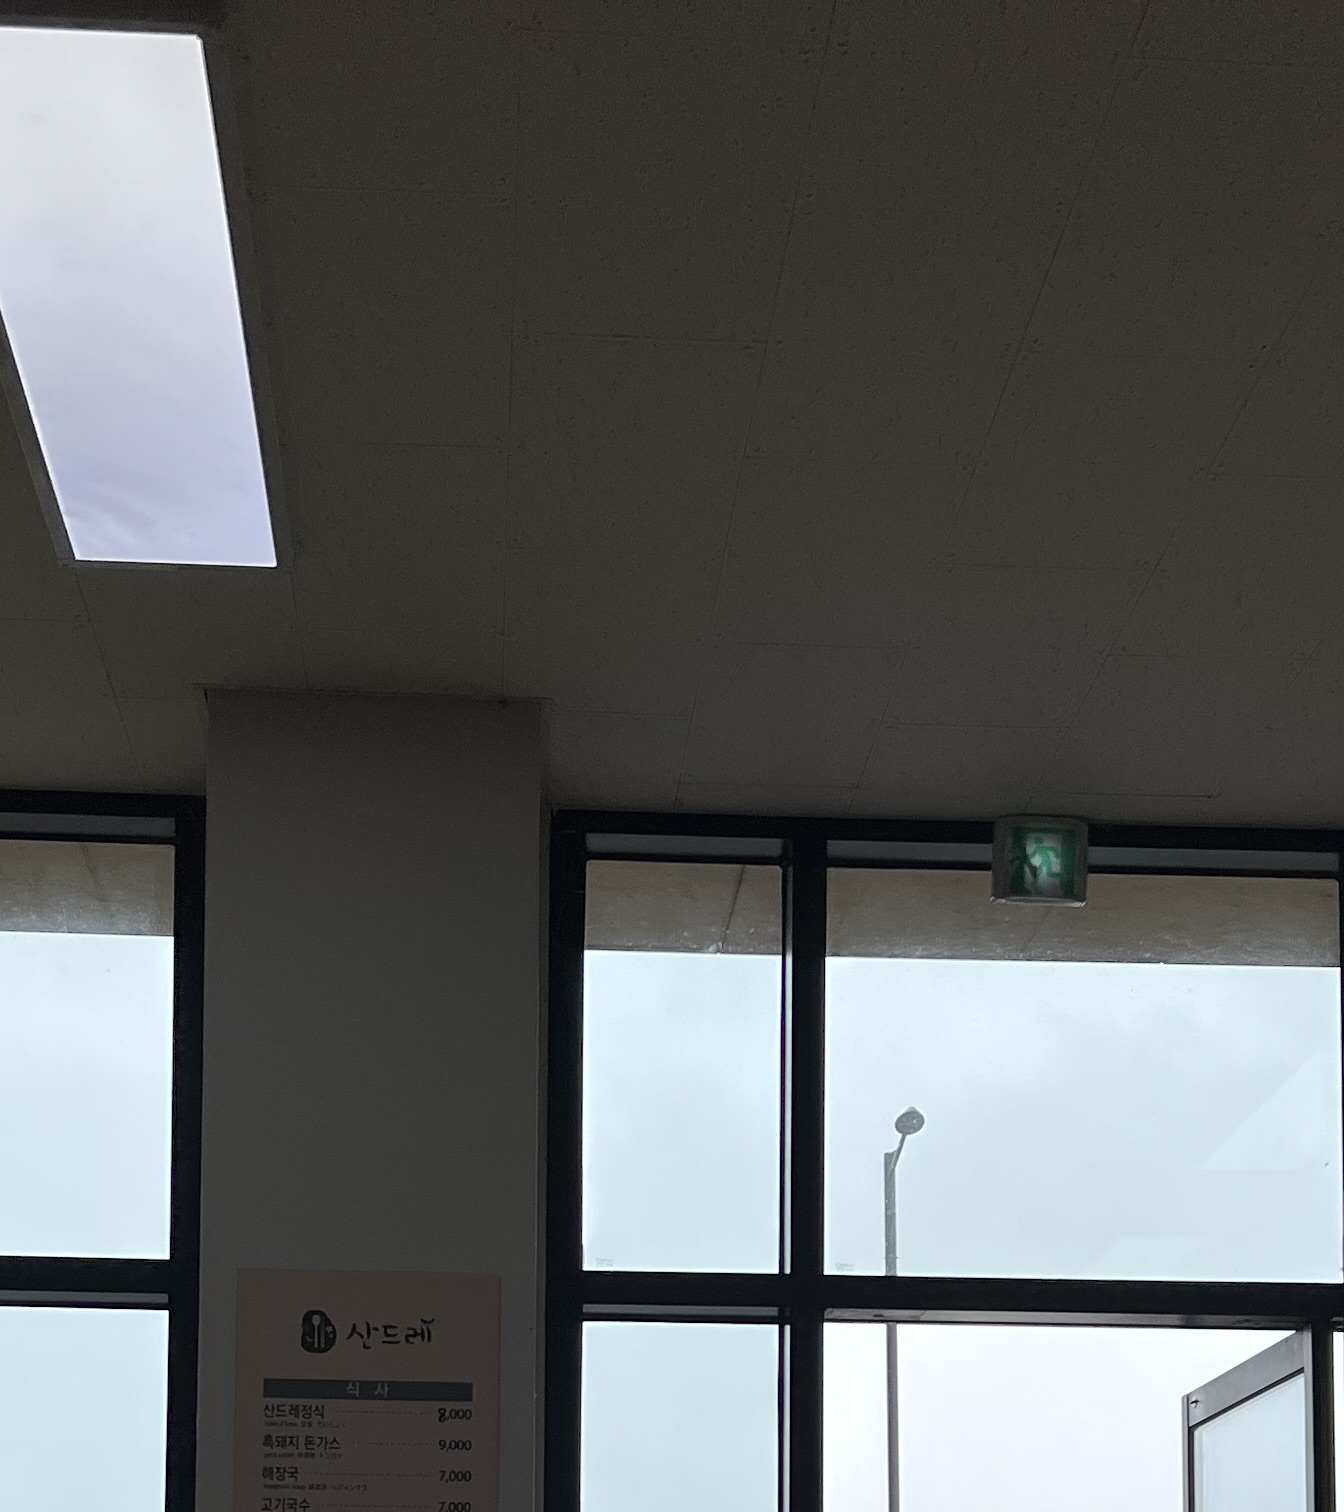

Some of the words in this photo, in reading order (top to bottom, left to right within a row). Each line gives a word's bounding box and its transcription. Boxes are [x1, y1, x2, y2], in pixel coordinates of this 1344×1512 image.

[346, 1318, 436, 1350] 산드레
[263, 1403, 325, 1419] 산드레정식
[262, 1434, 300, 1450] 흑돼지
[303, 1435, 341, 1450] 돈가스
[438, 1438, 472, 1452] 9,000
[262, 1466, 299, 1481] 해장국
[438, 1470, 472, 1484] 7,000
[261, 1497, 311, 1512] 고기국수
